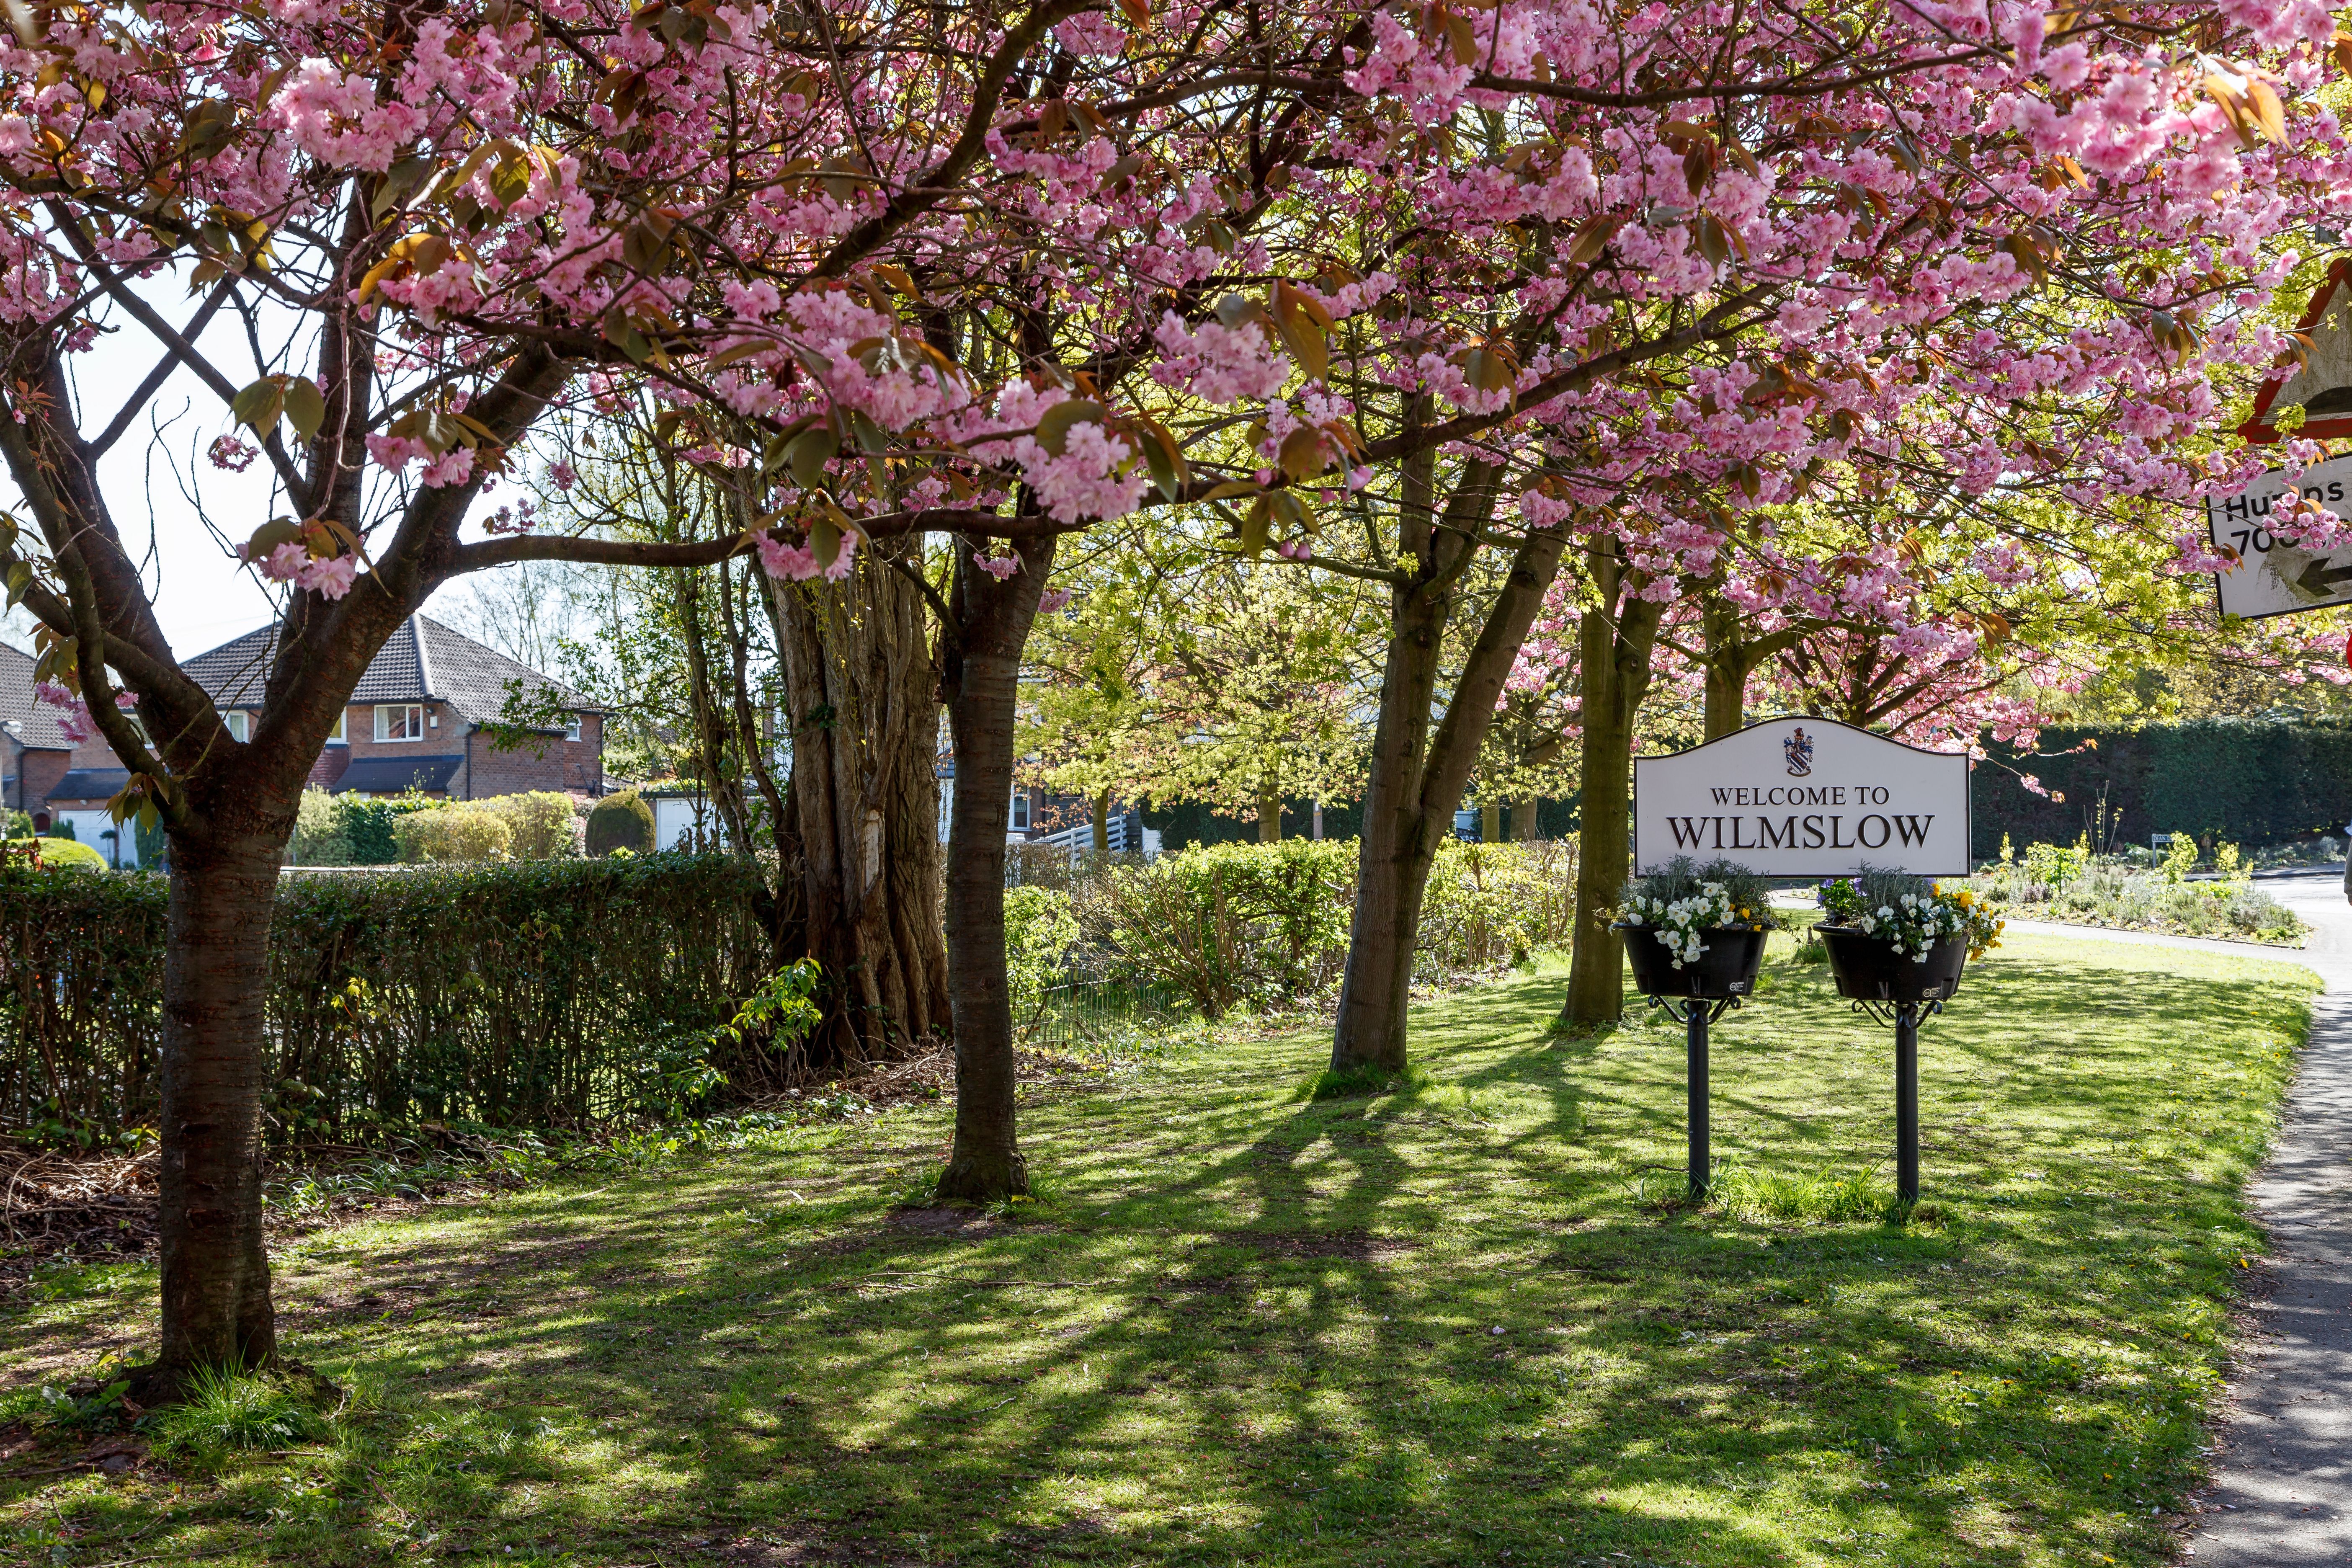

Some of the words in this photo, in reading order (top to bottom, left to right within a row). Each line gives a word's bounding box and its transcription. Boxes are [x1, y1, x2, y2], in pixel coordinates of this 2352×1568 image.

[1710, 787, 1847, 806] WELCOME
[1855, 787, 1890, 805] TO
[1666, 815, 1935, 849] WILMSLOW
